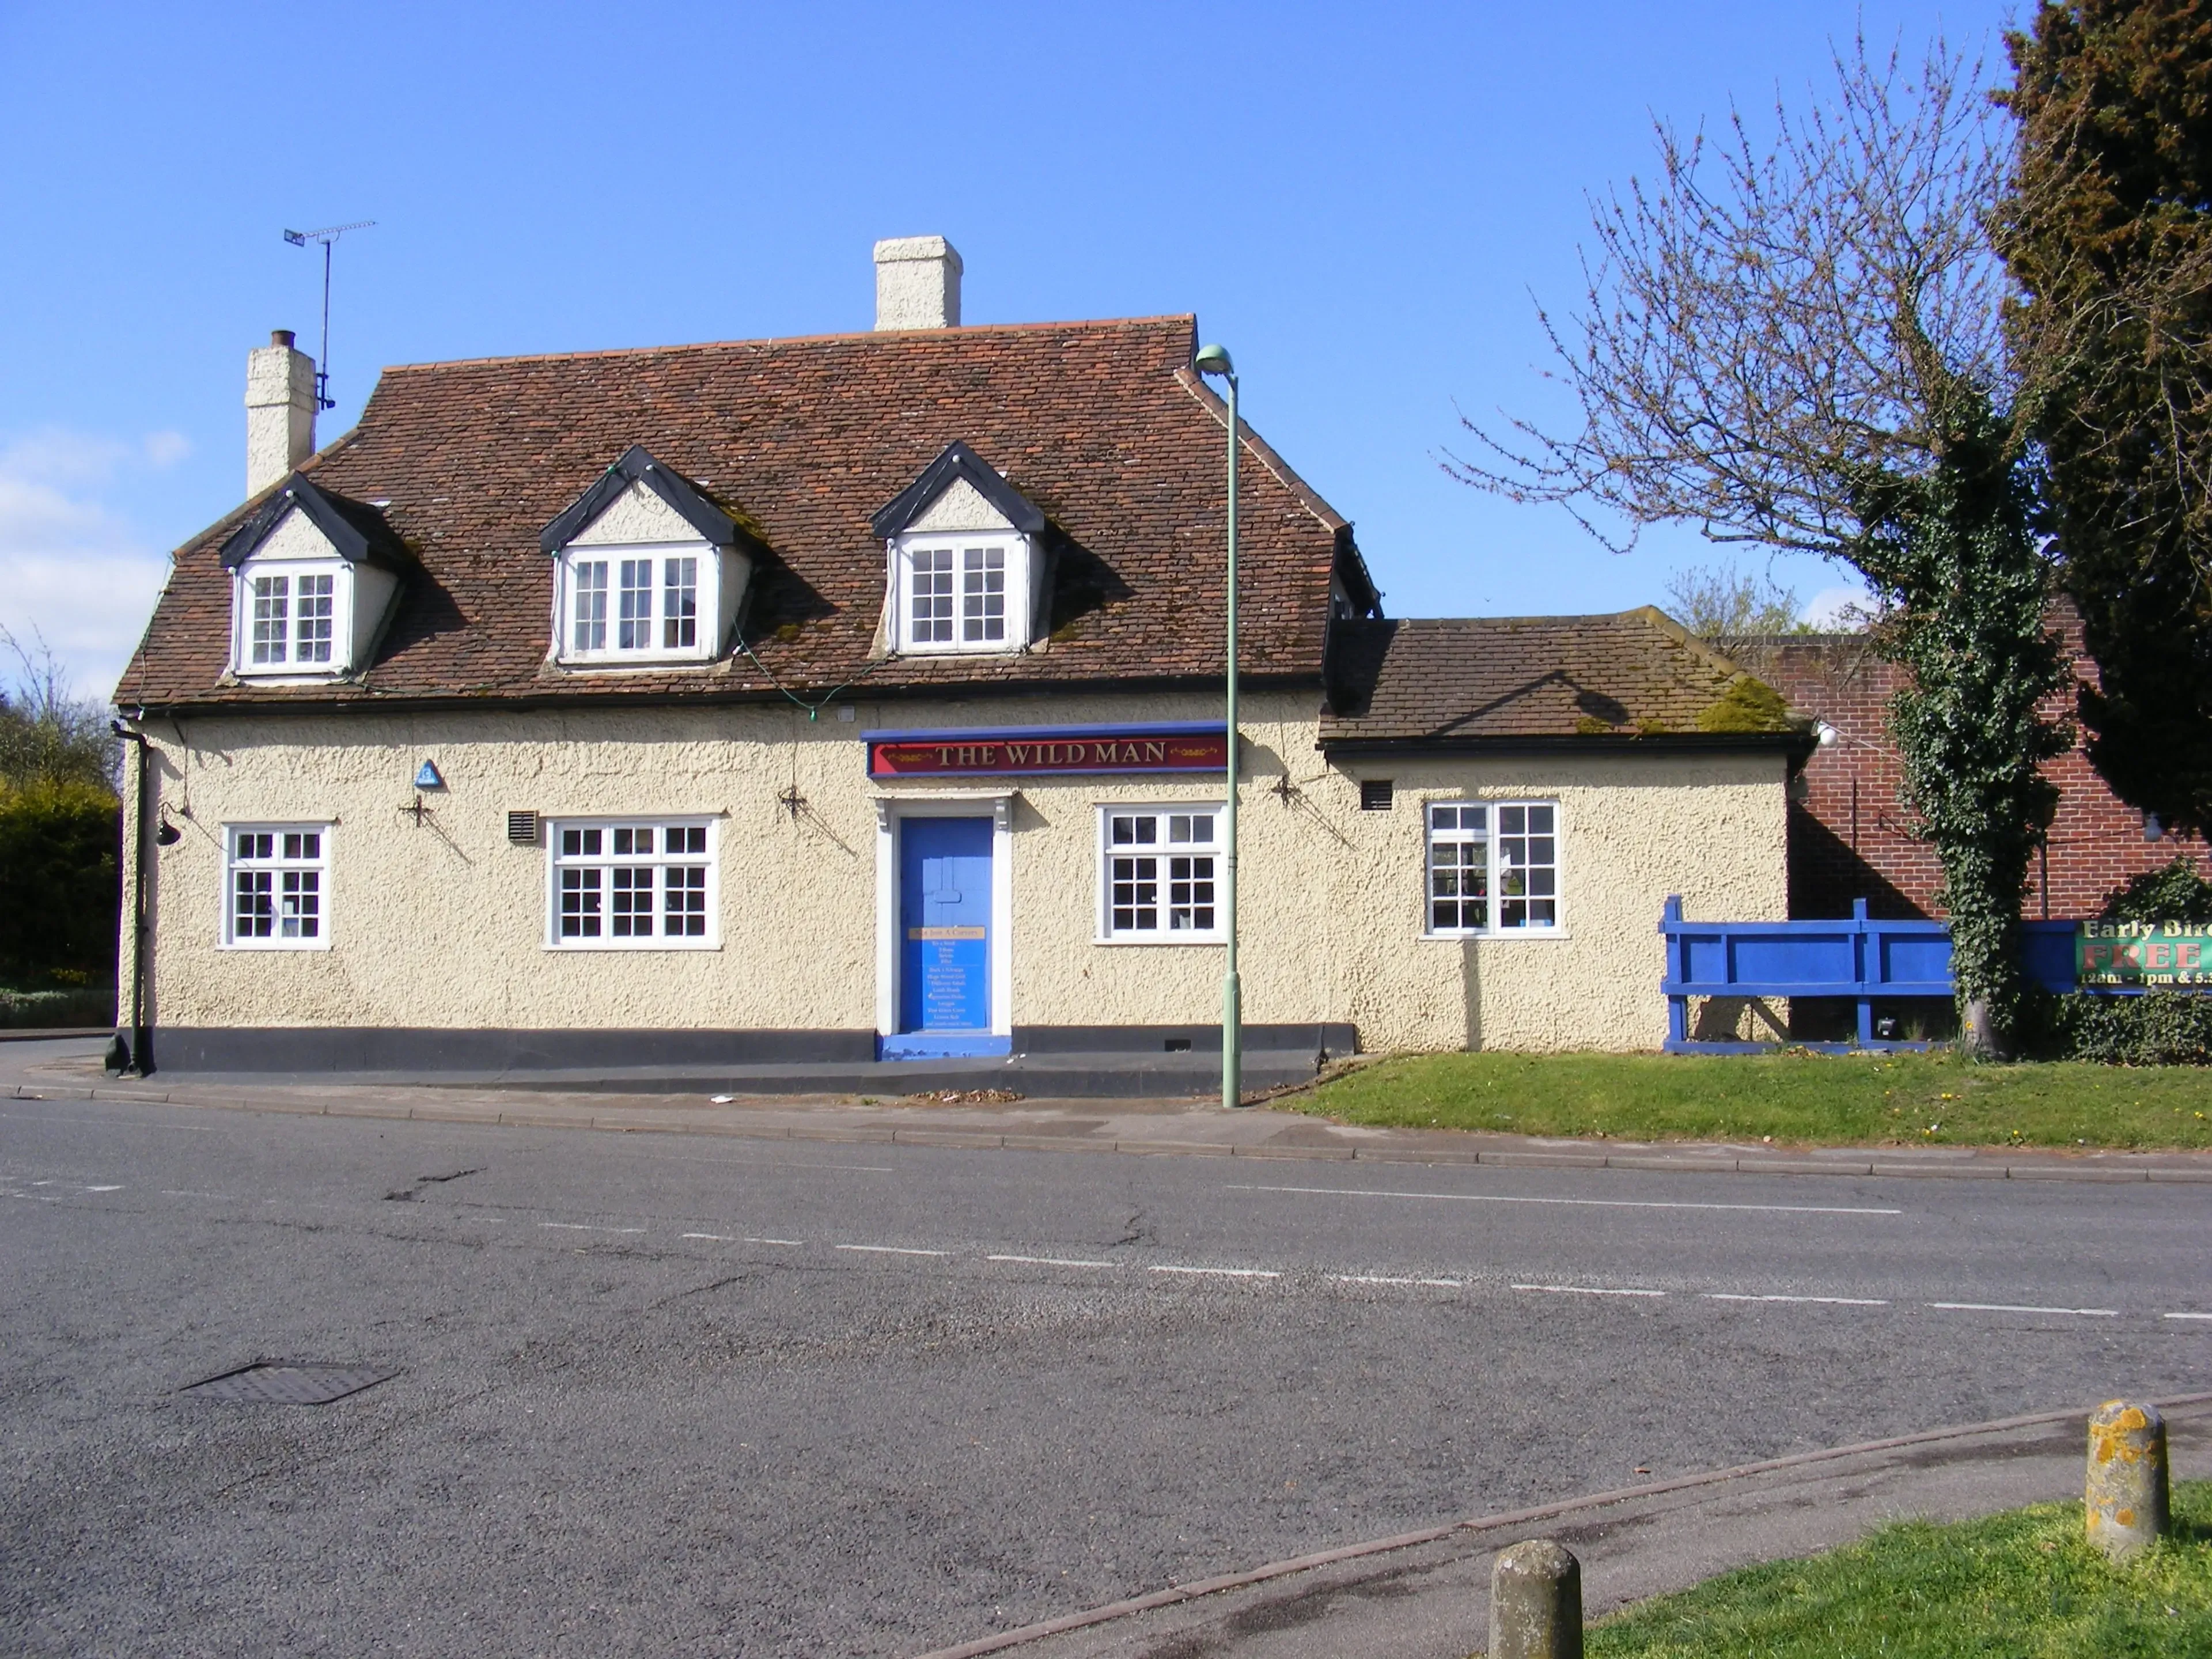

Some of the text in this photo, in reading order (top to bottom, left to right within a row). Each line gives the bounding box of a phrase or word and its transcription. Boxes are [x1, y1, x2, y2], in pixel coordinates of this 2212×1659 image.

[935, 742, 1166, 766] THE WILD MAN
[2082, 920, 2156, 941] Early
[2082, 943, 2200, 969] FREE
[2139, 972, 2173, 986] 1pm
[2177, 971, 2192, 984] &
